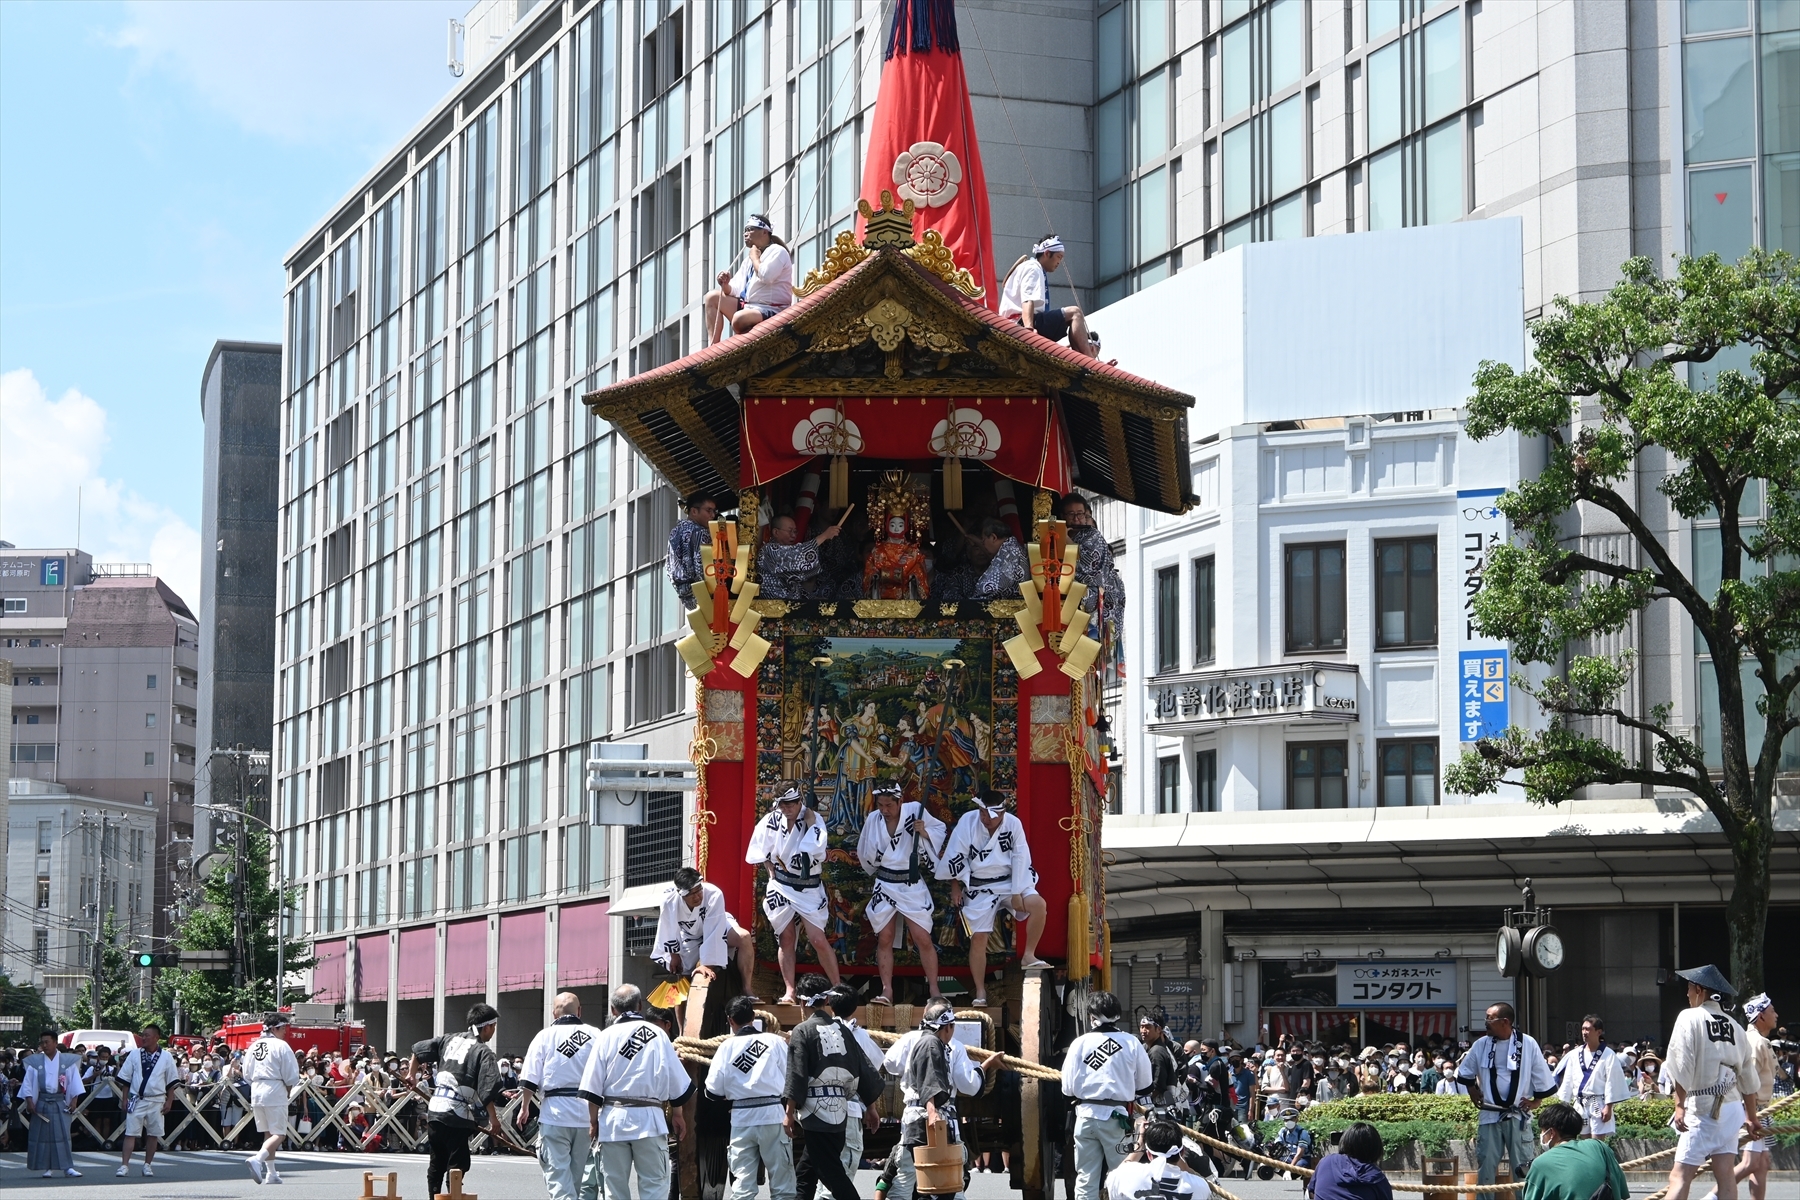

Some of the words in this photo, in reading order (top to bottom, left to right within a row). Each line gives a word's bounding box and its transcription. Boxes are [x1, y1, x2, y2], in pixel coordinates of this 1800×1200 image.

[0, 561, 36, 569] テムコート
[1485, 660, 1501, 700] すぐ
[1154, 677, 1303, 718] 池善化粧品店
[1463, 659, 1481, 739] 買えます
[1382, 968, 1442, 978] メガネスーパー
[1353, 981, 1442, 1000] コンタクト
